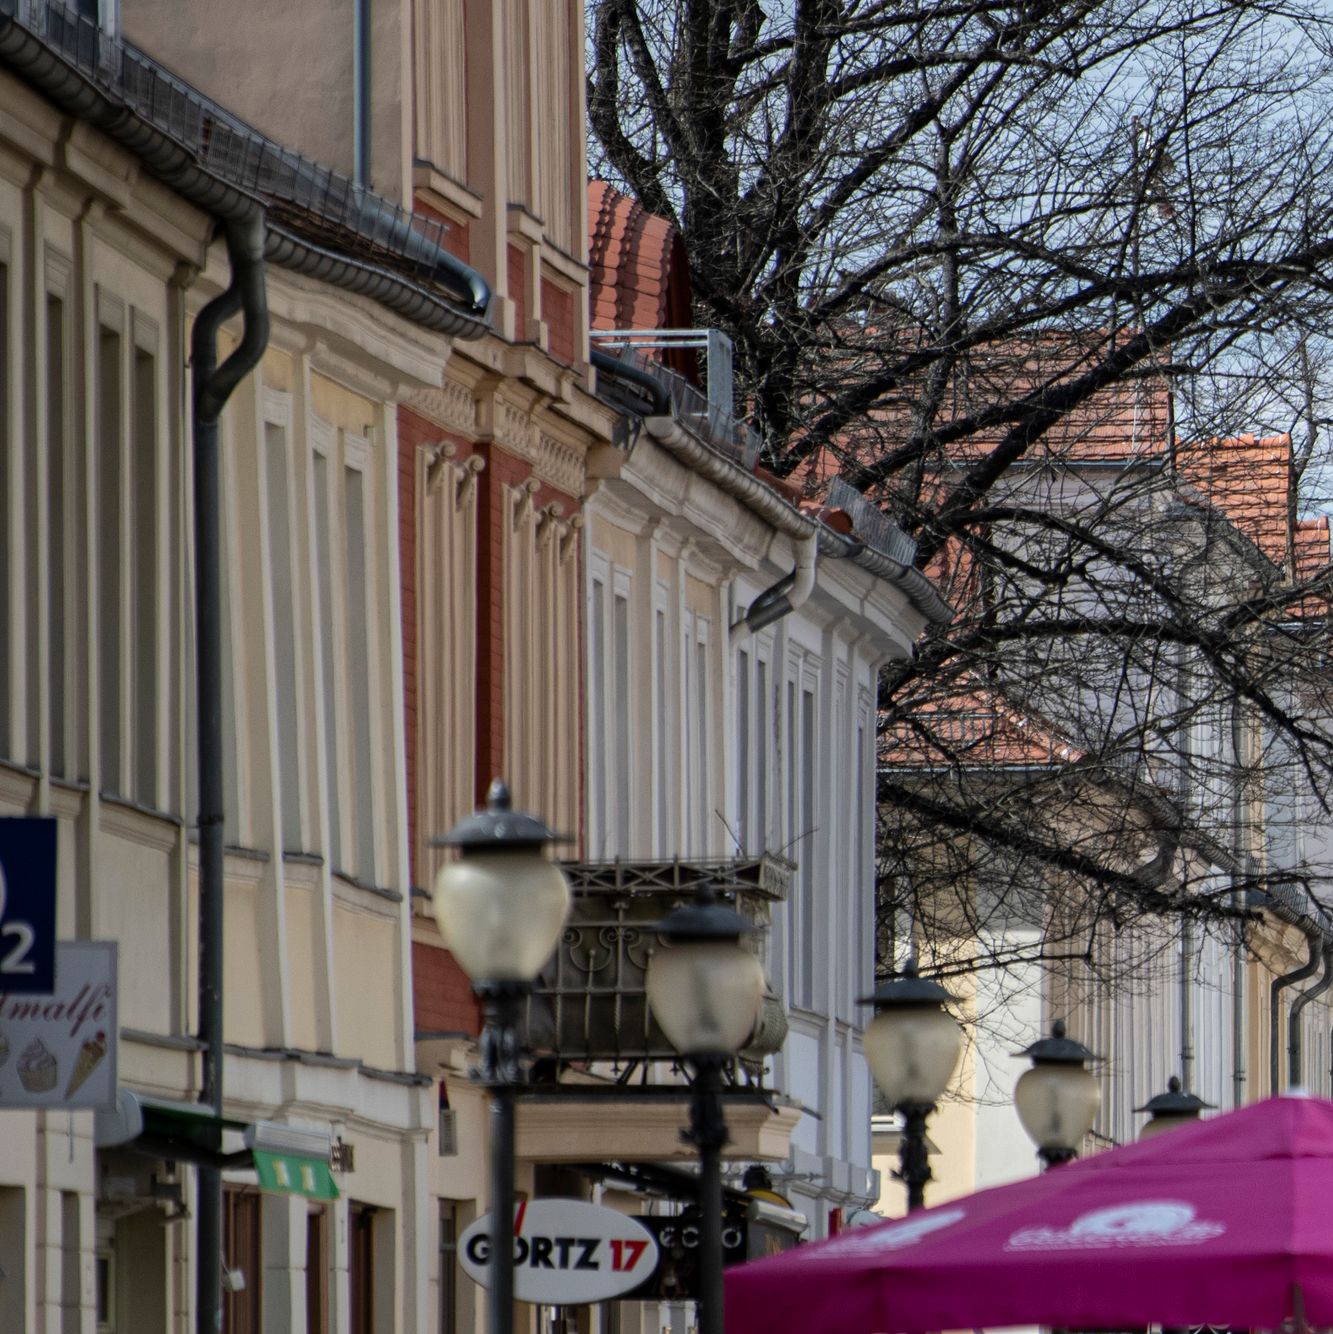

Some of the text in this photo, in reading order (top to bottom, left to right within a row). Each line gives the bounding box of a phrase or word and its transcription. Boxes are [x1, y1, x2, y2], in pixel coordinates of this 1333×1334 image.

[0, 982, 111, 1038] malfi
[659, 1226, 743, 1249] eco
[610, 1239, 650, 1272] 17
